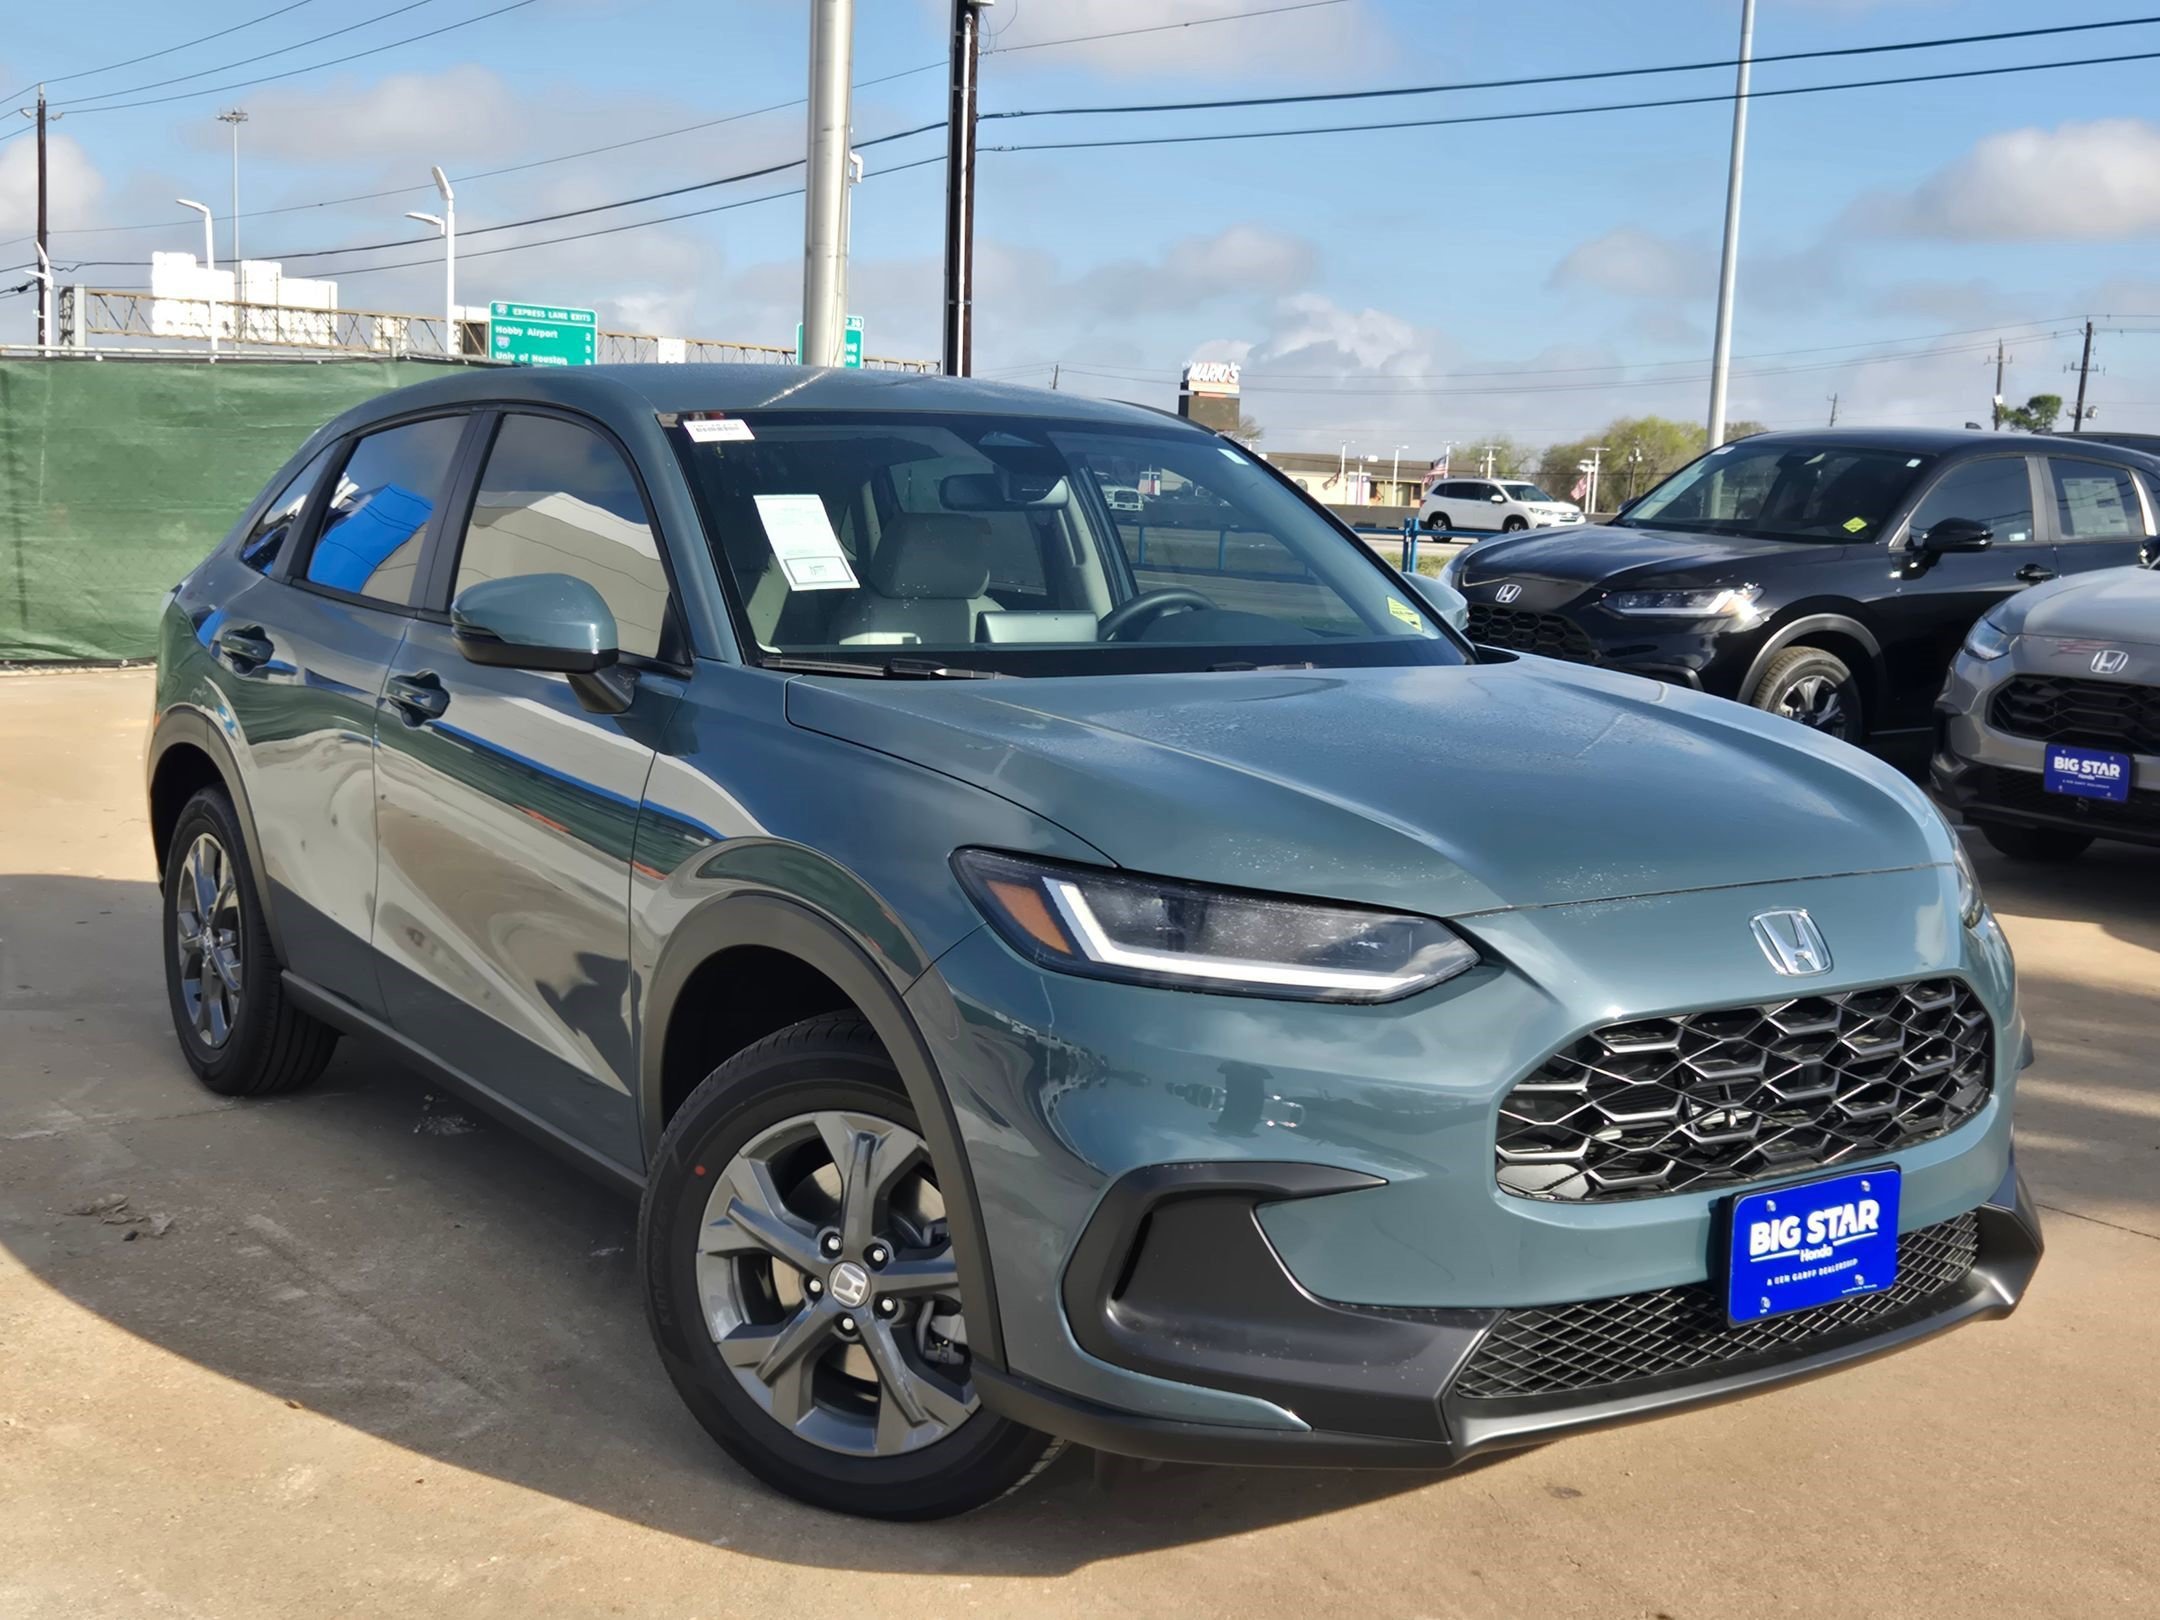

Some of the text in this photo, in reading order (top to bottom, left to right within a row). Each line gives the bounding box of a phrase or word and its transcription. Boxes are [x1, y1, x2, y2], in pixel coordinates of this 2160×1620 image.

[512, 308, 592, 322] EXPRESS LANE EXITS
[495, 325, 523, 336] Hobby
[527, 328, 558, 339] Airport
[495, 351, 568, 366] Univ of Houston
[2053, 756, 2080, 771] BIG
[2081, 760, 2120, 778] STAR
[1749, 1199, 1880, 1256] BIG STAR
[1800, 1243, 1833, 1262] Honda
